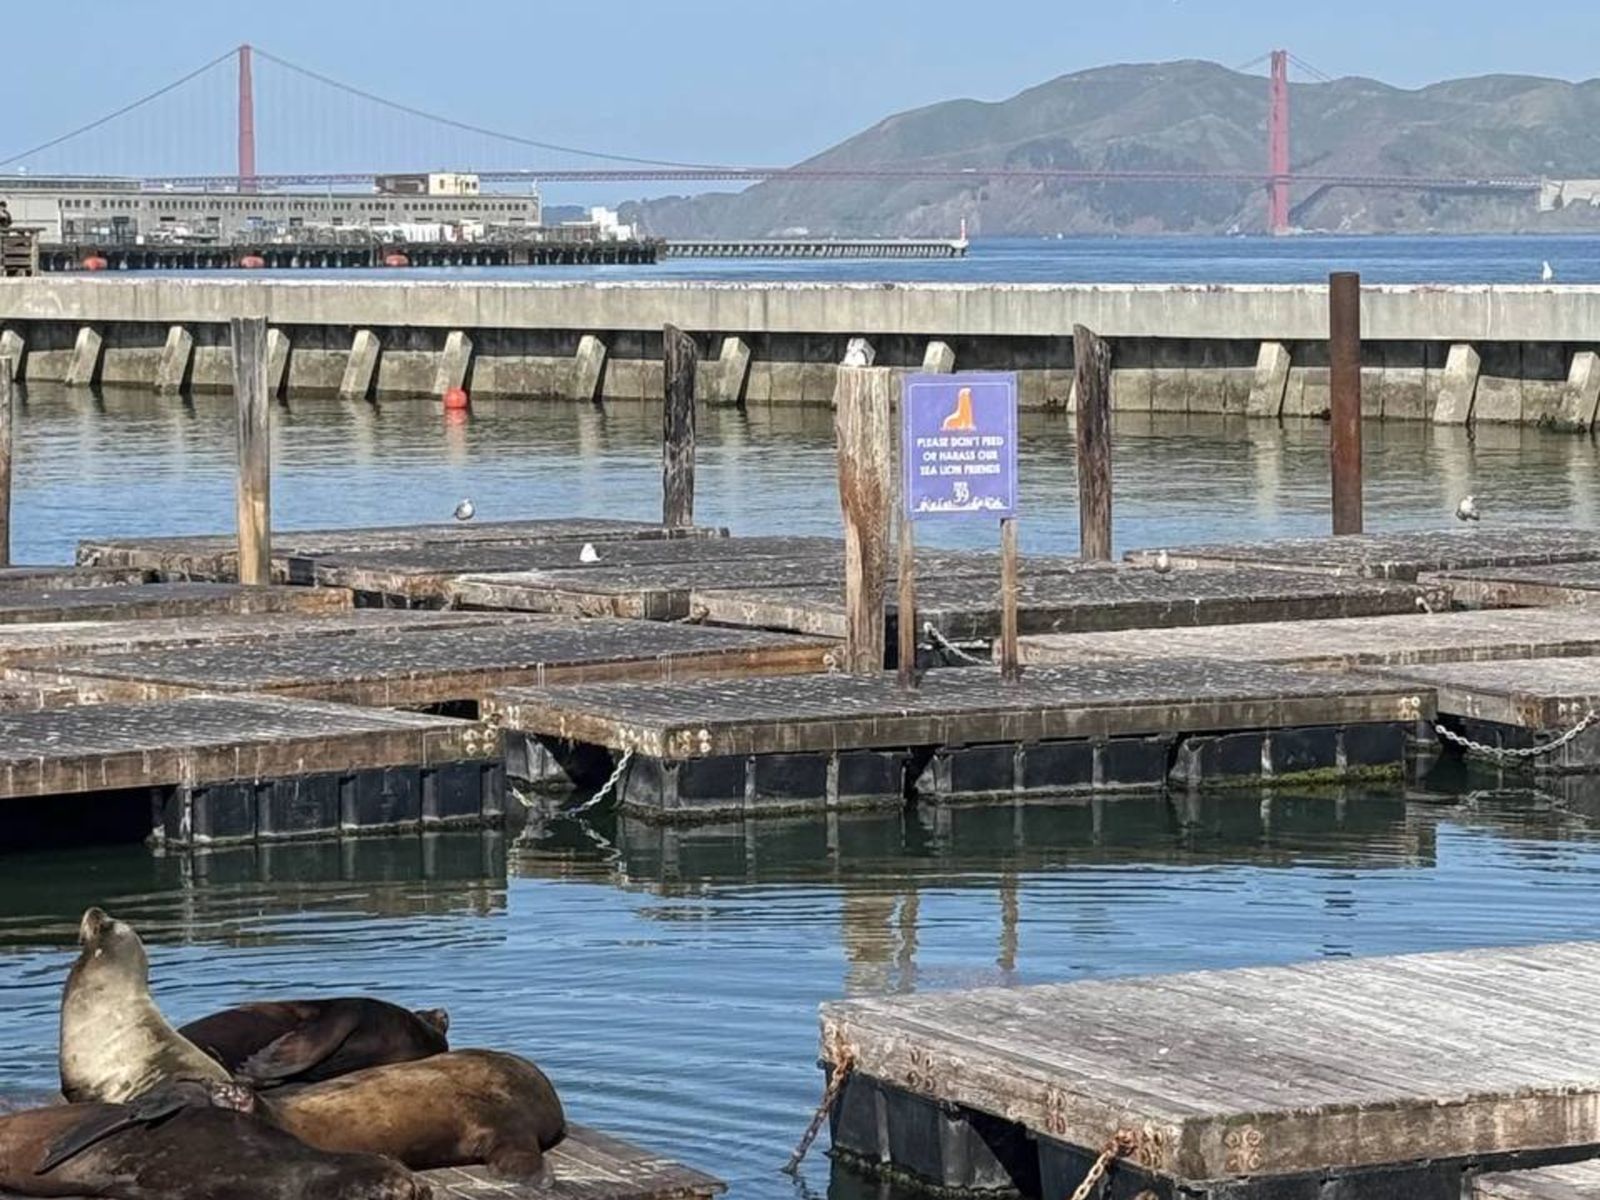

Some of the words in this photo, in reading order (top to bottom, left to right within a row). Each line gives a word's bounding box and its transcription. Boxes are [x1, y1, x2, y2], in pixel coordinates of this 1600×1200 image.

[923, 452, 937, 461] OR
[978, 451, 998, 460] OUR
[920, 466, 937, 476] SEA
[940, 465, 961, 475] LION
